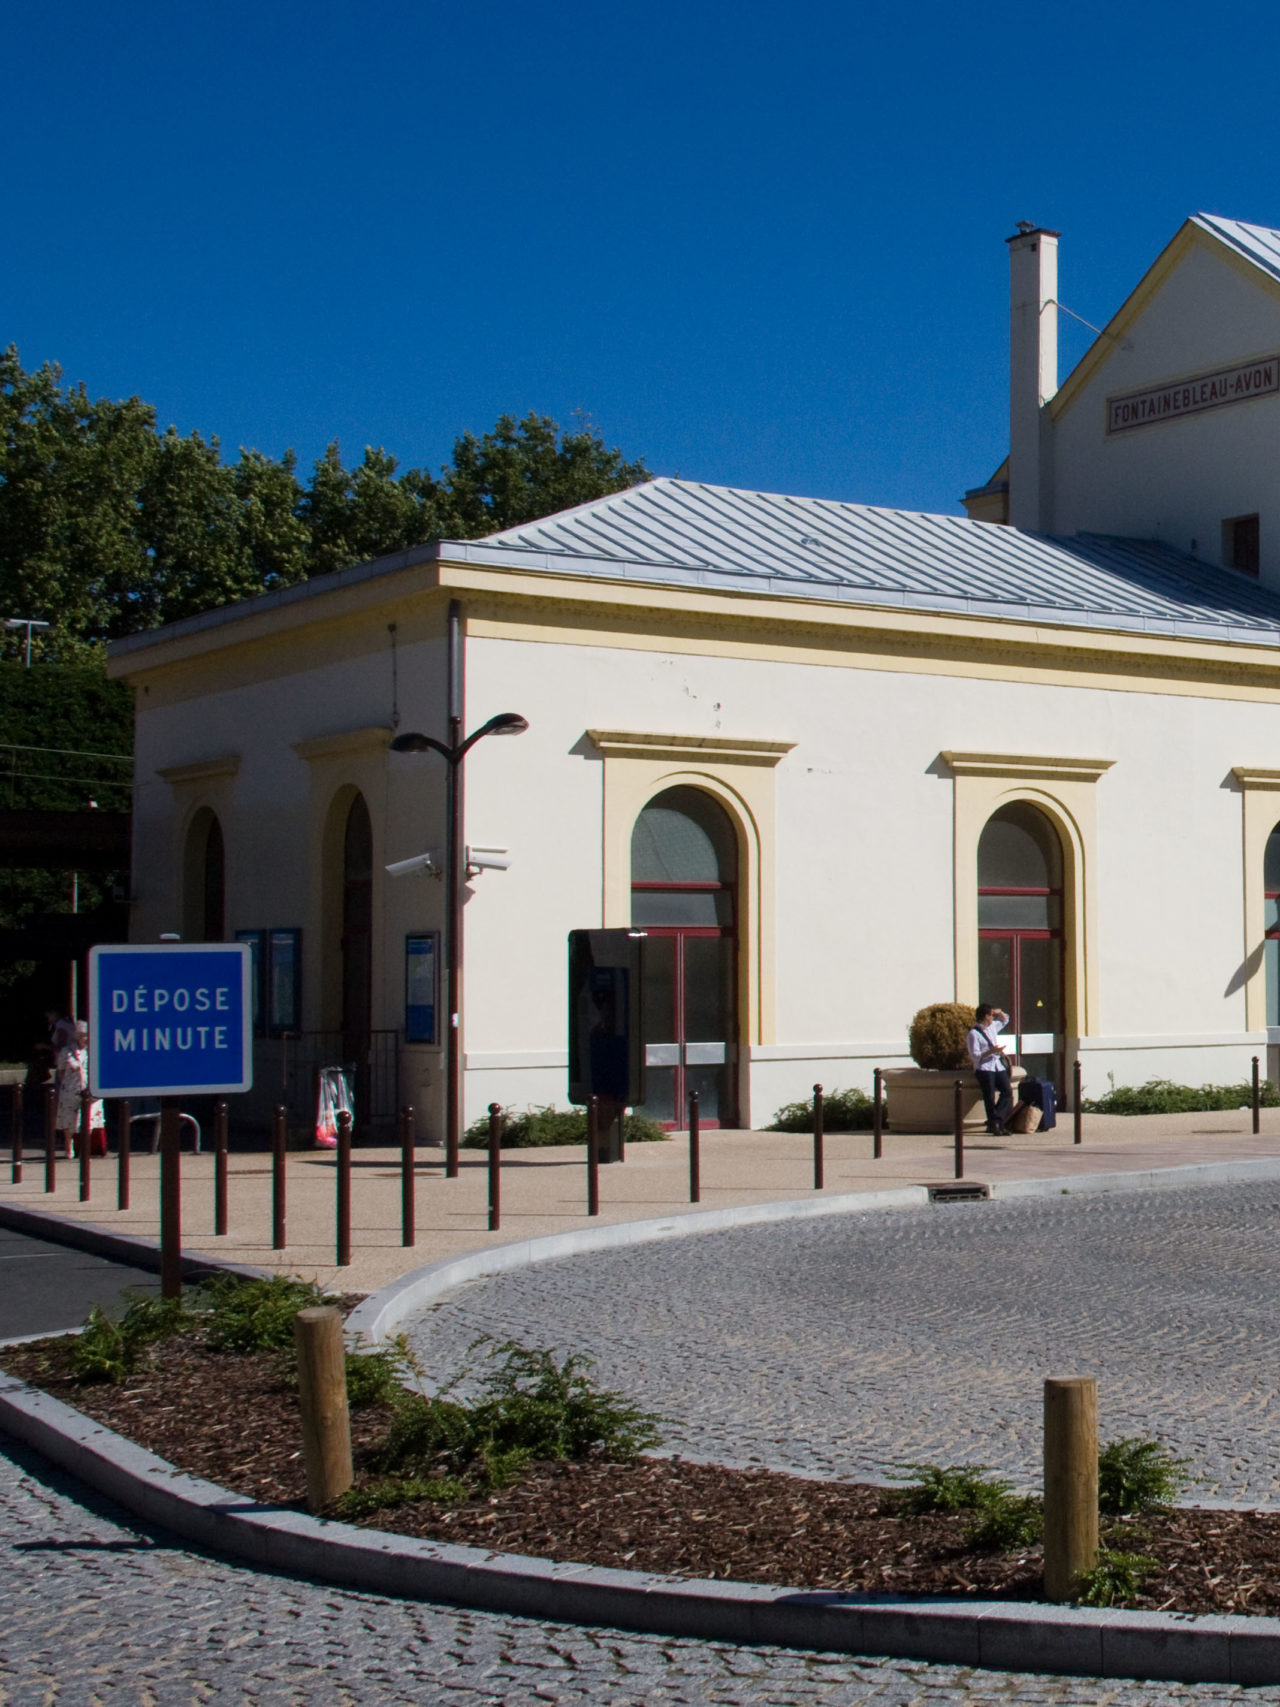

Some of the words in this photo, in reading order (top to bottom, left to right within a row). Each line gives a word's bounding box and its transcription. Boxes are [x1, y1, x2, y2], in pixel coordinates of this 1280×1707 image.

[1114, 366, 1273, 425] FONTAINEBLEAU-AVON
[112, 985, 230, 1014] DÉPOSE
[114, 1026, 229, 1052] MINUTE
